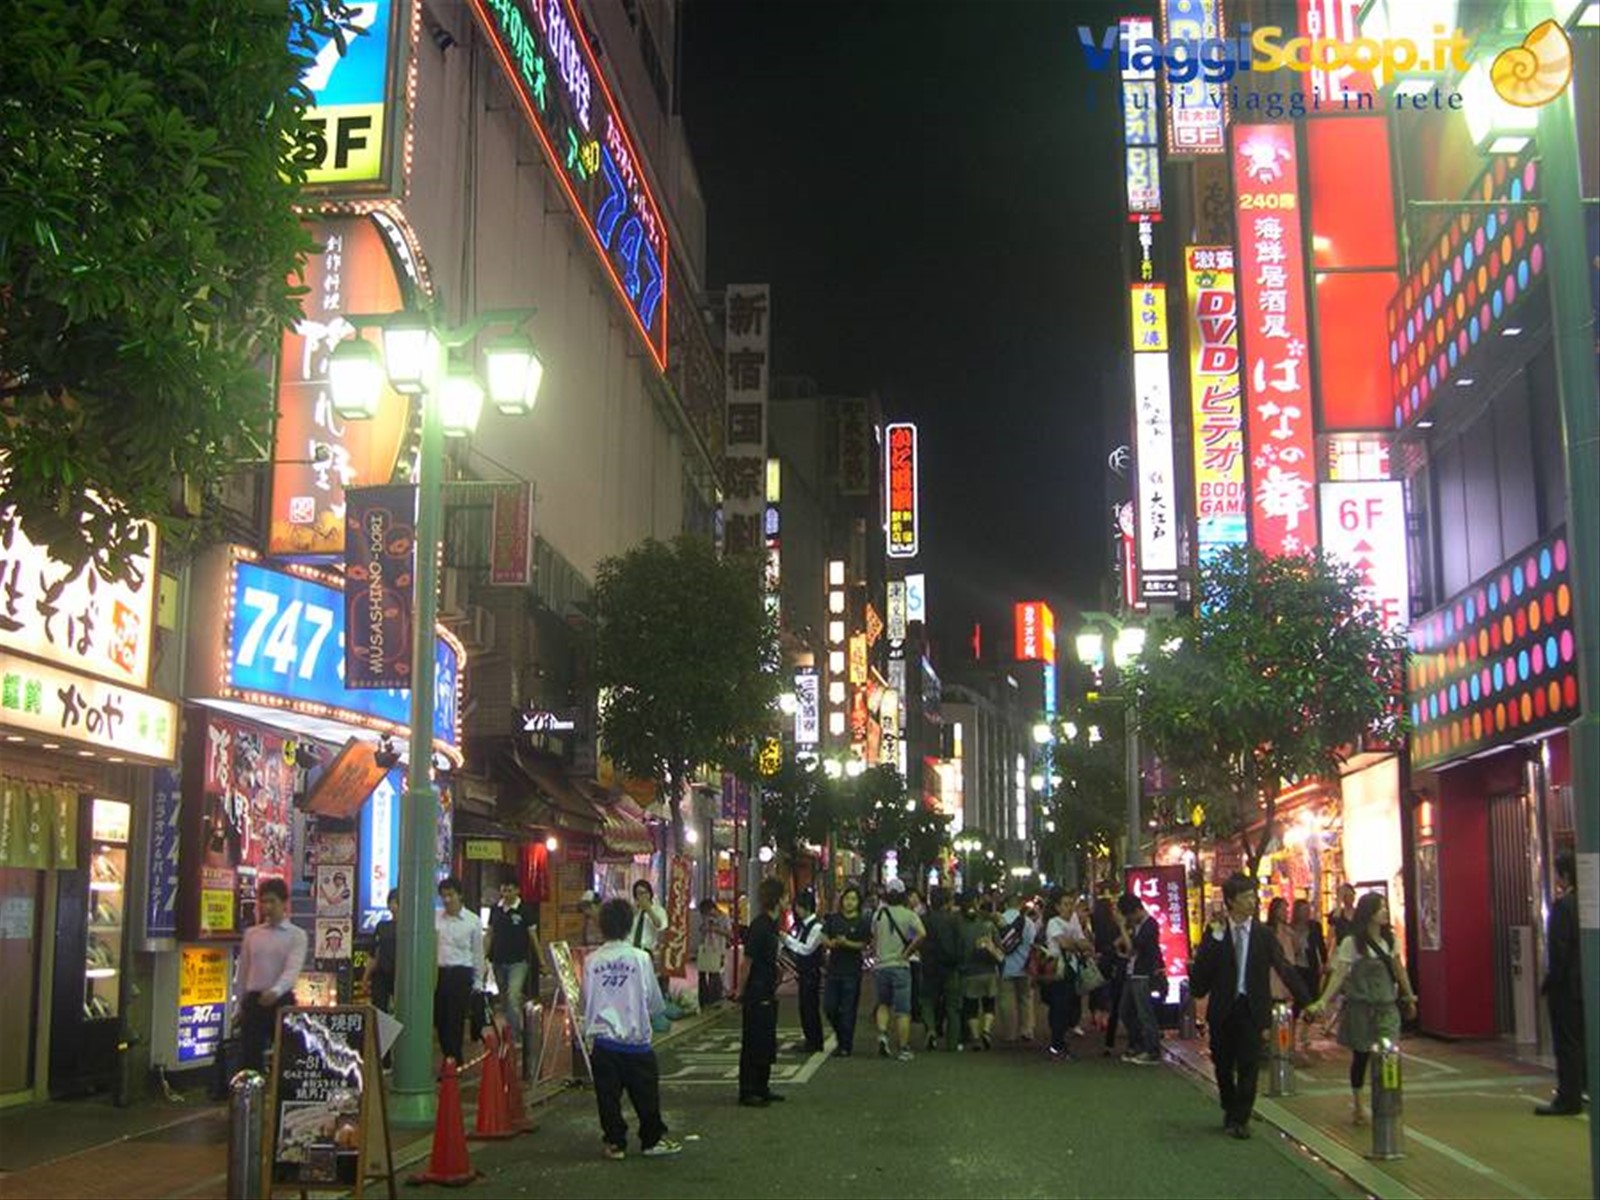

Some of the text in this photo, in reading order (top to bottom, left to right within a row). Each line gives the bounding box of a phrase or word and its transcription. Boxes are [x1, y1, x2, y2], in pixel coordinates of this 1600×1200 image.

[1179, 127, 1219, 144] 5F
[323, 234, 343, 311] 創作料理
[1254, 216, 1292, 339] 海鮮居酒屋
[1338, 498, 1384, 532] 6F
[369, 513, 386, 675] MUSASHINO-DORI
[237, 586, 334, 681] 747
[57, 683, 124, 740] かのや
